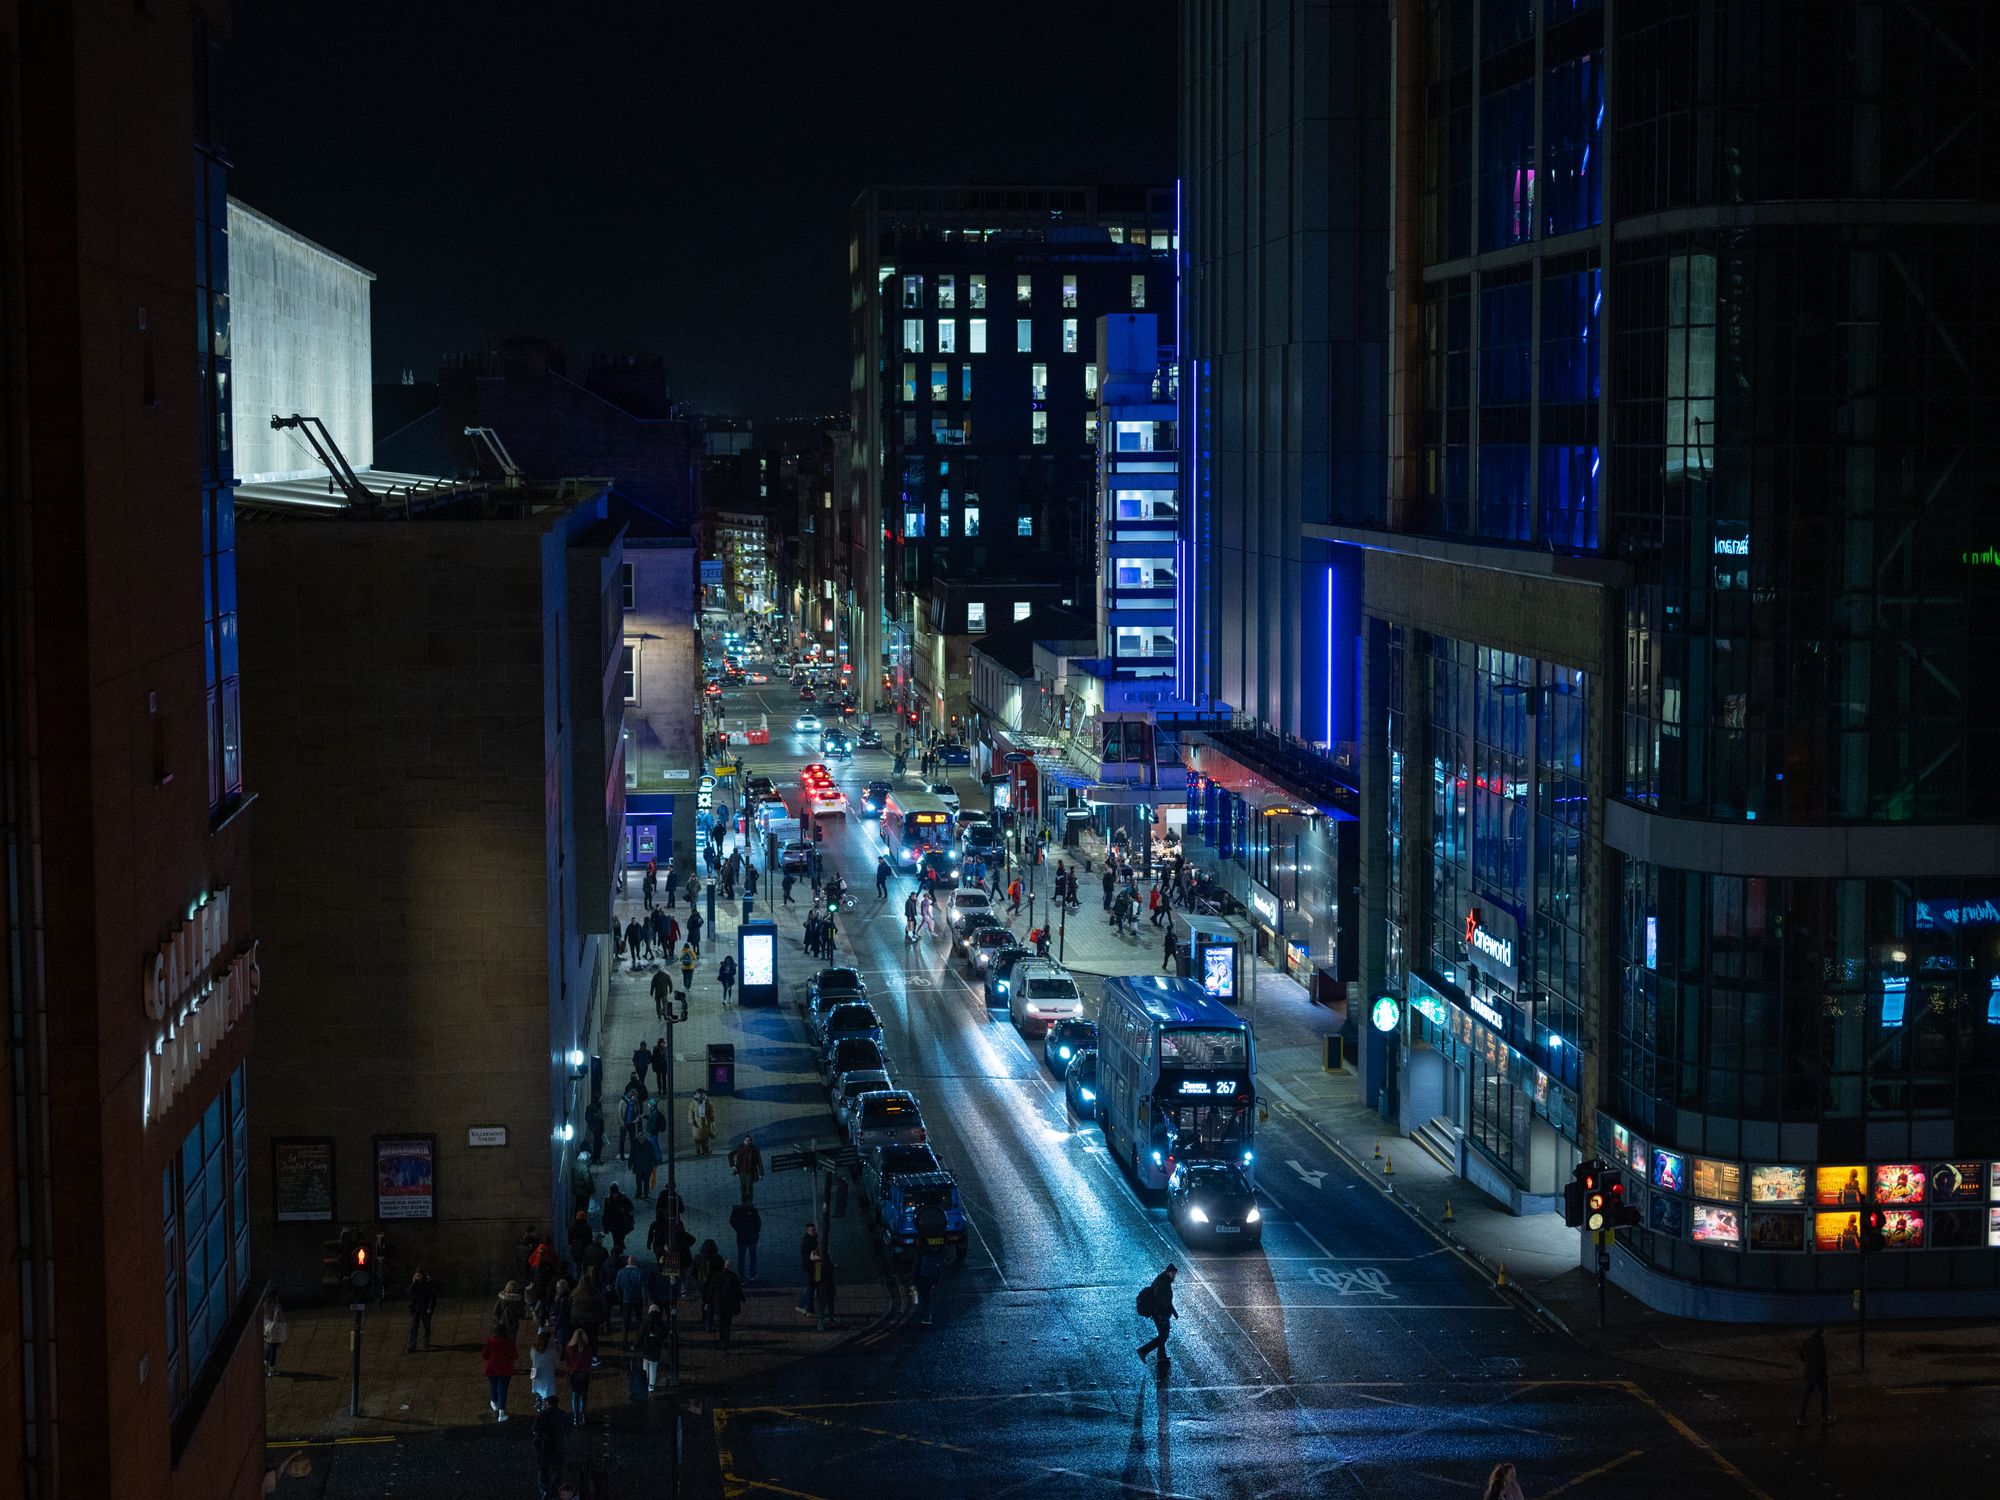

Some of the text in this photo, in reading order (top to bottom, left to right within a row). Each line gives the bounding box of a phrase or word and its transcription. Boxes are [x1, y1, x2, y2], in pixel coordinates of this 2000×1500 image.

[144, 884, 231, 1021] GALLERY
[1473, 925, 1511, 968] cineworld
[1470, 995, 1503, 1031] STARBUCKS
[142, 939, 261, 1133] APARTMENTS
[1216, 1081, 1237, 1094] 267
[280, 1160, 329, 1175] Joyful Song
